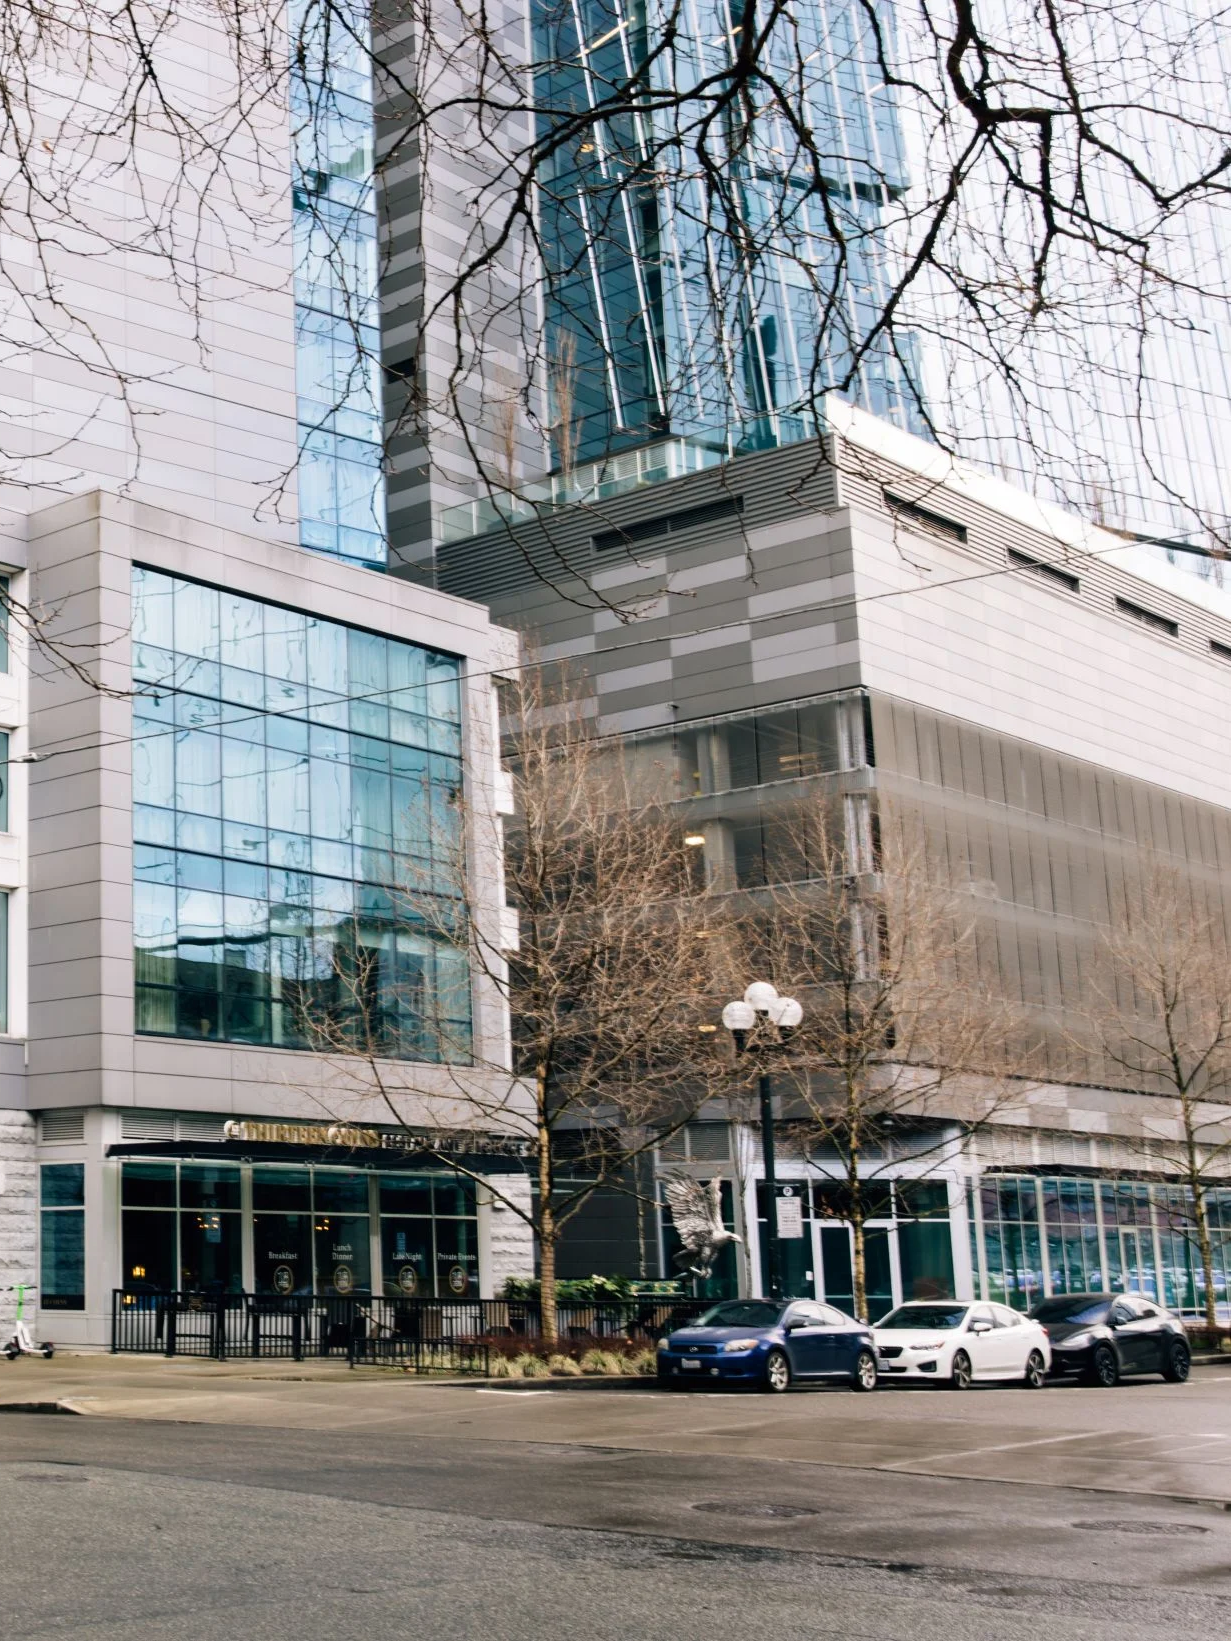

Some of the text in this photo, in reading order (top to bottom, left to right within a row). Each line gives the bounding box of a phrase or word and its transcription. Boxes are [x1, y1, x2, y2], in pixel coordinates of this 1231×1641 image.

[239, 1121, 328, 1144] THIRTEEN
[328, 1127, 379, 1147] COINS
[332, 1243, 352, 1251] Lunch
[268, 1251, 298, 1260] Breakfast
[332, 1252, 353, 1260] Dinner
[406, 1252, 422, 1262] Night
[437, 1252, 476, 1261] Private Events
